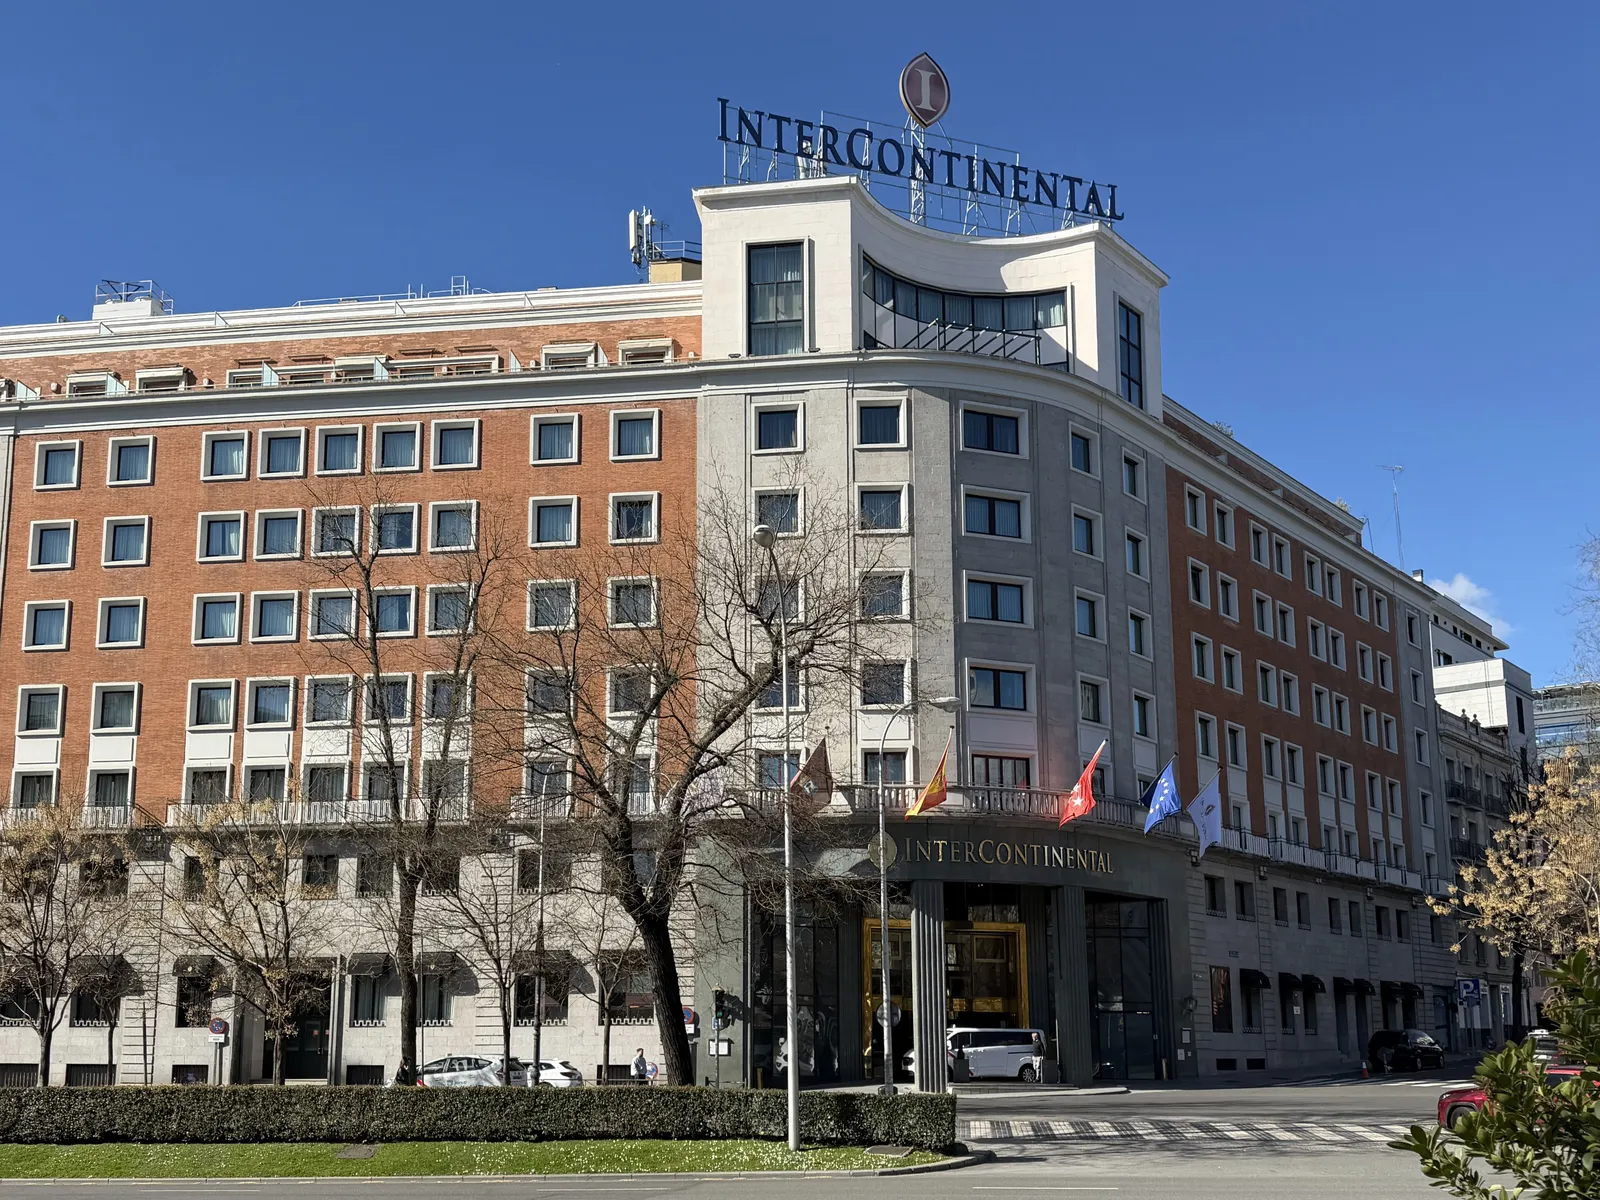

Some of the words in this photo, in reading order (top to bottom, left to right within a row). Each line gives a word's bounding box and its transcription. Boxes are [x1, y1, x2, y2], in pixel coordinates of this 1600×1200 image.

[915, 68, 937, 112] I
[717, 98, 1124, 220] INTERCONTINENTAL
[904, 837, 1113, 873] INTERCONTINENTAL
[1460, 981, 1474, 998] P
